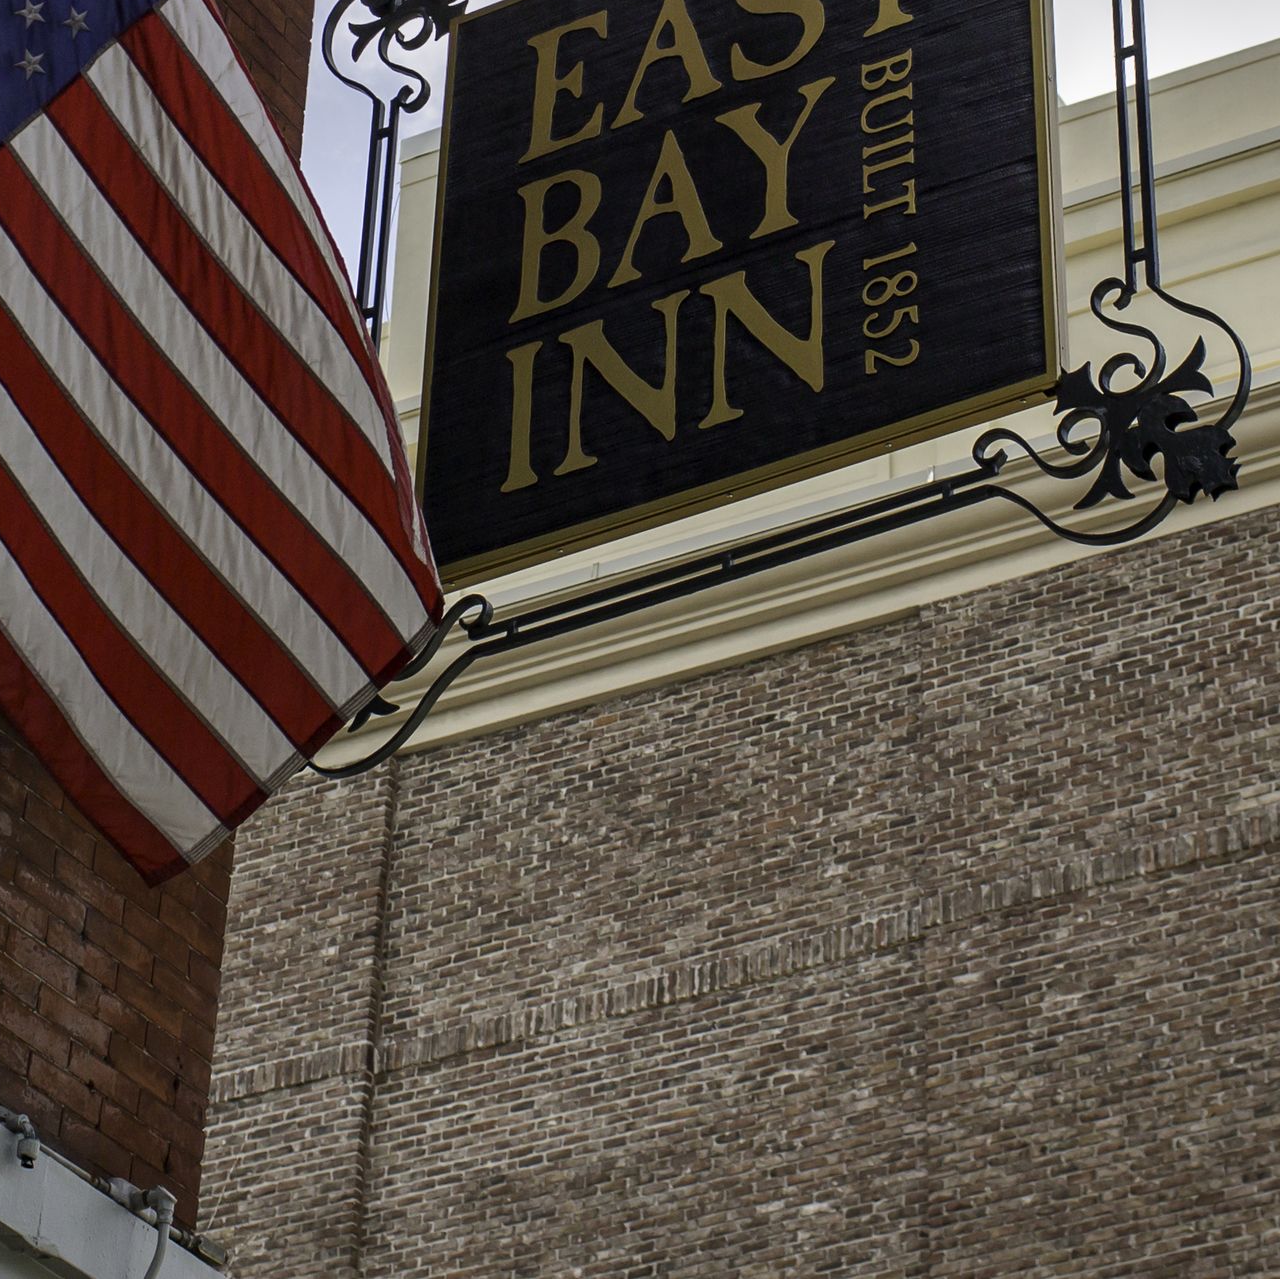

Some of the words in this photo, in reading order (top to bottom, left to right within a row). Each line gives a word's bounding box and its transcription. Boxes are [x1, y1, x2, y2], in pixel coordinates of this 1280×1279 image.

[508, 76, 836, 324] BAY
[861, 49, 917, 220] BUILT
[500, 240, 836, 494] INN
[862, 242, 920, 375] 1852
